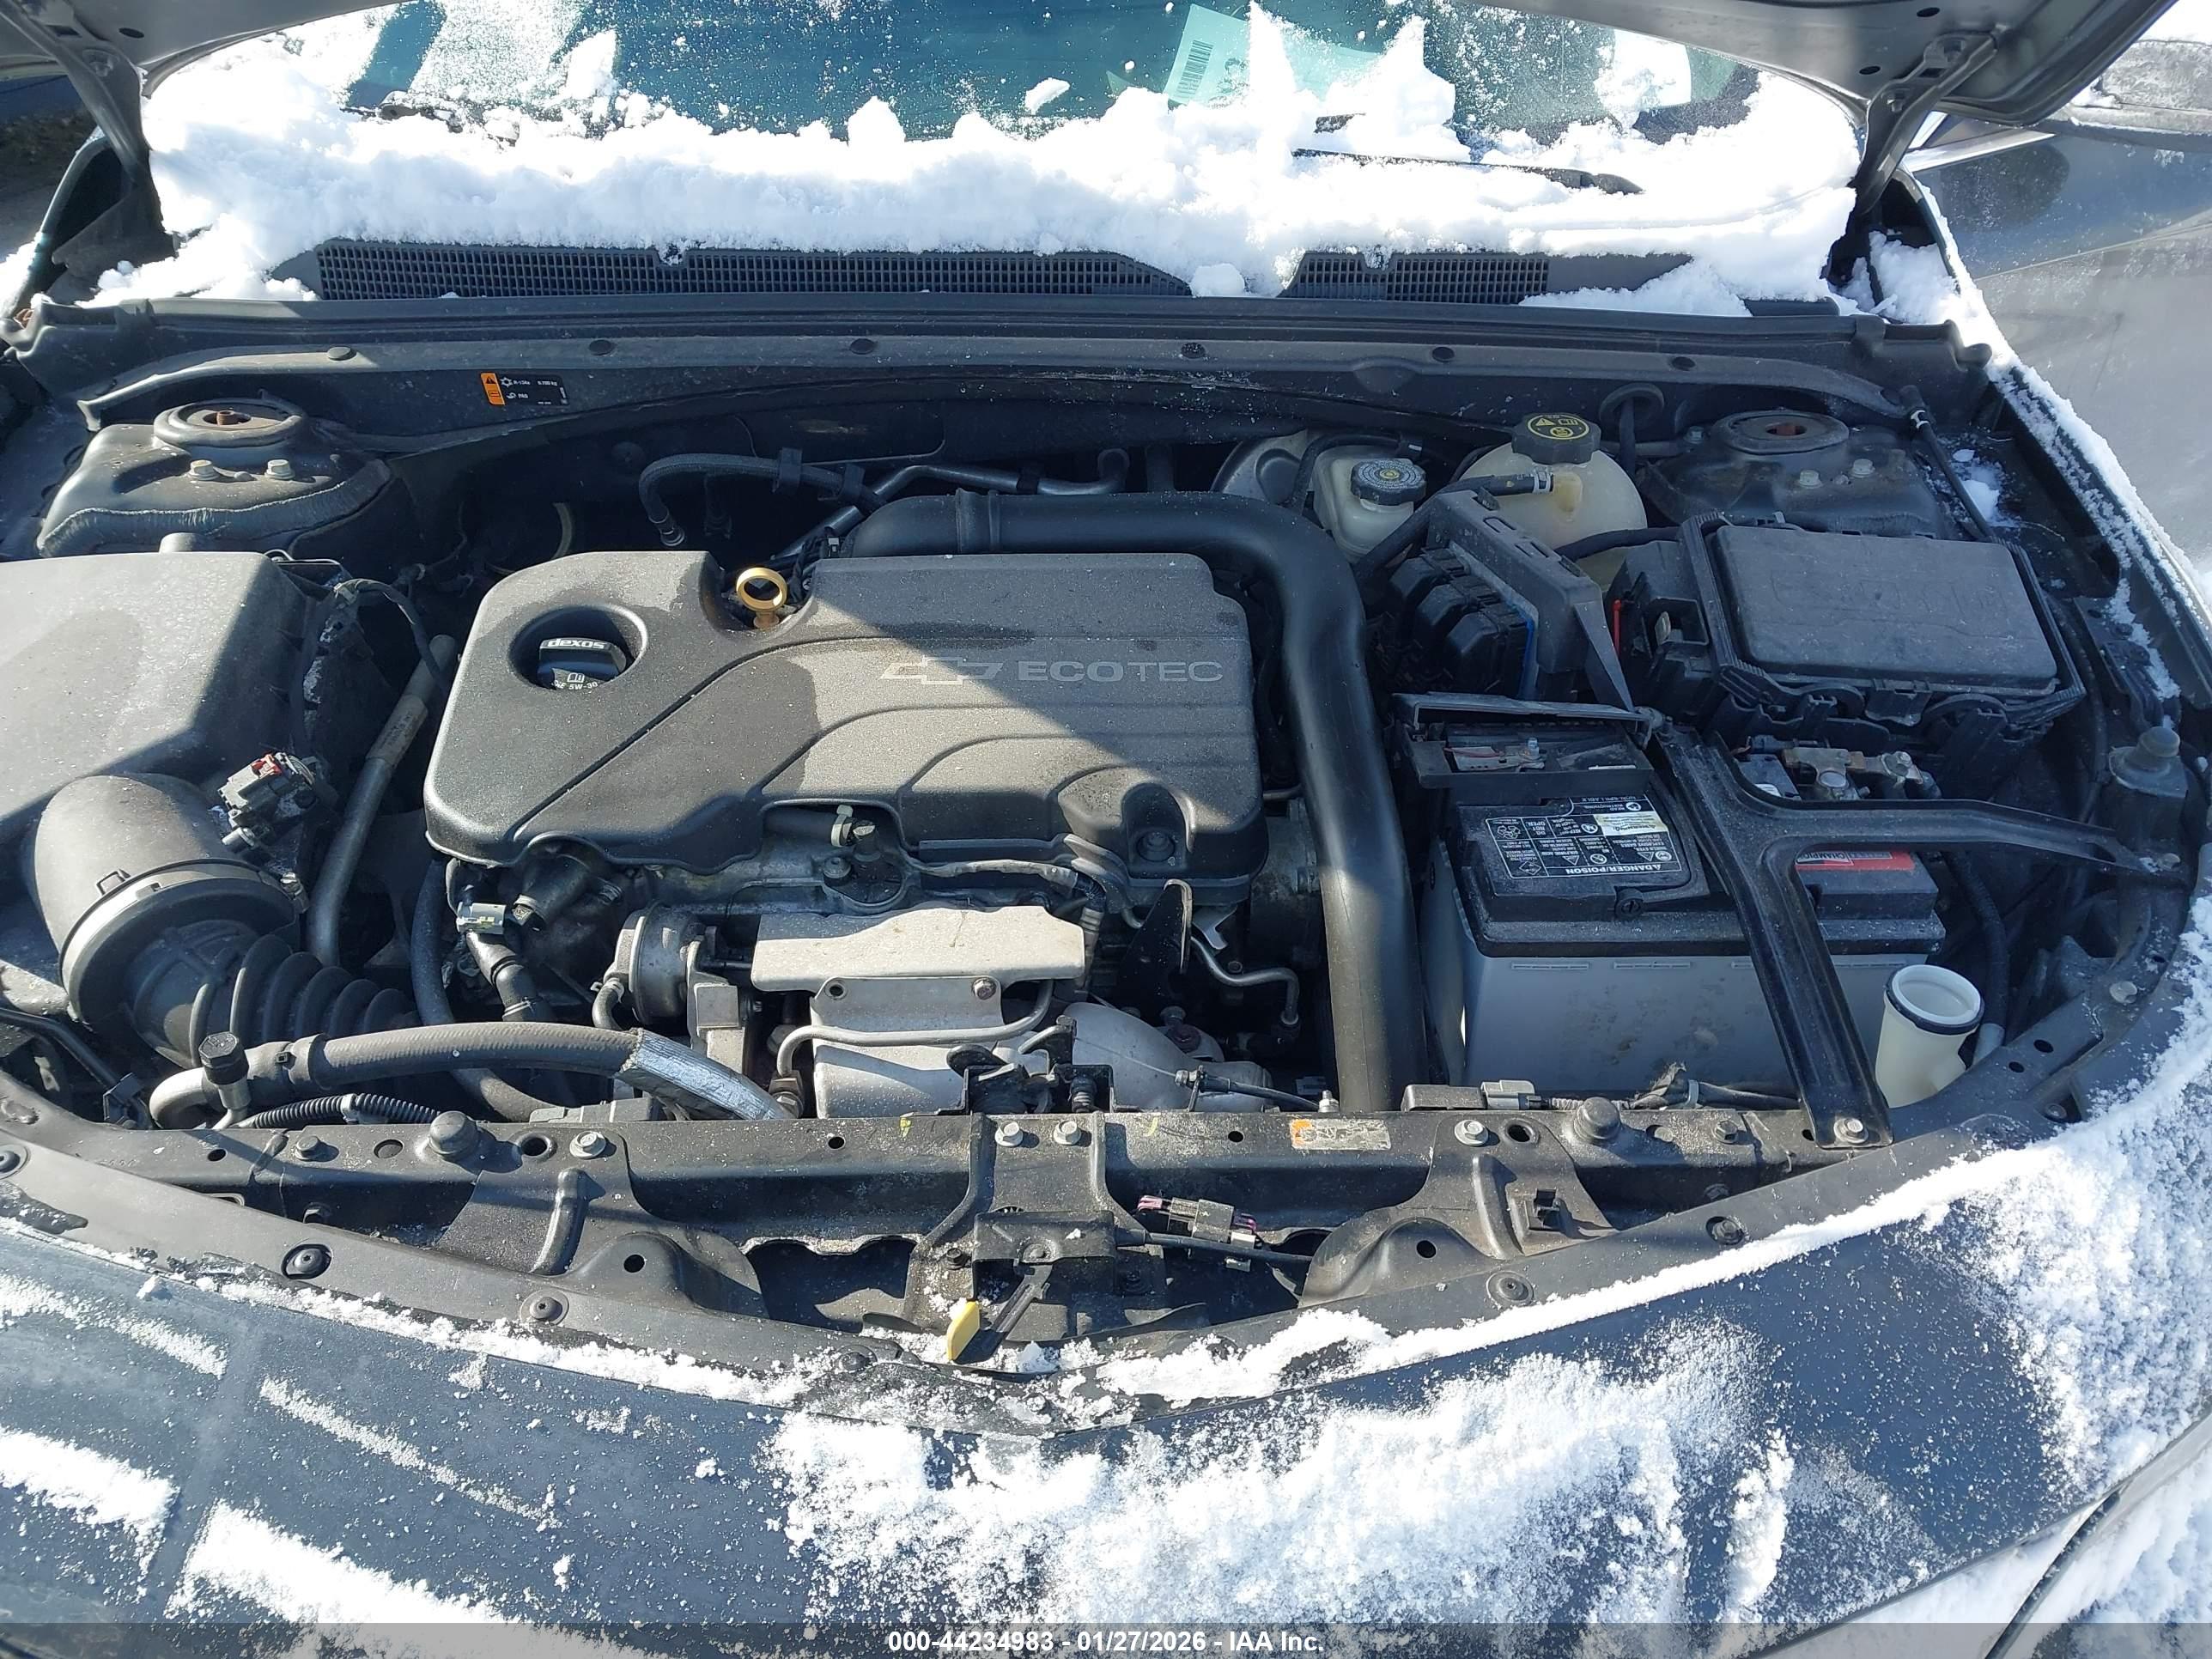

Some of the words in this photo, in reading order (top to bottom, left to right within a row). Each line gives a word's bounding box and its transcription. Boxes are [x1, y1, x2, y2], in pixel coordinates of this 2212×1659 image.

[548, 638, 606, 649] dexos
[1018, 660, 1224, 683] ECOTEC
[568, 681, 599, 690] 5W-30
[1565, 865, 1653, 875] DANGER/POISON
